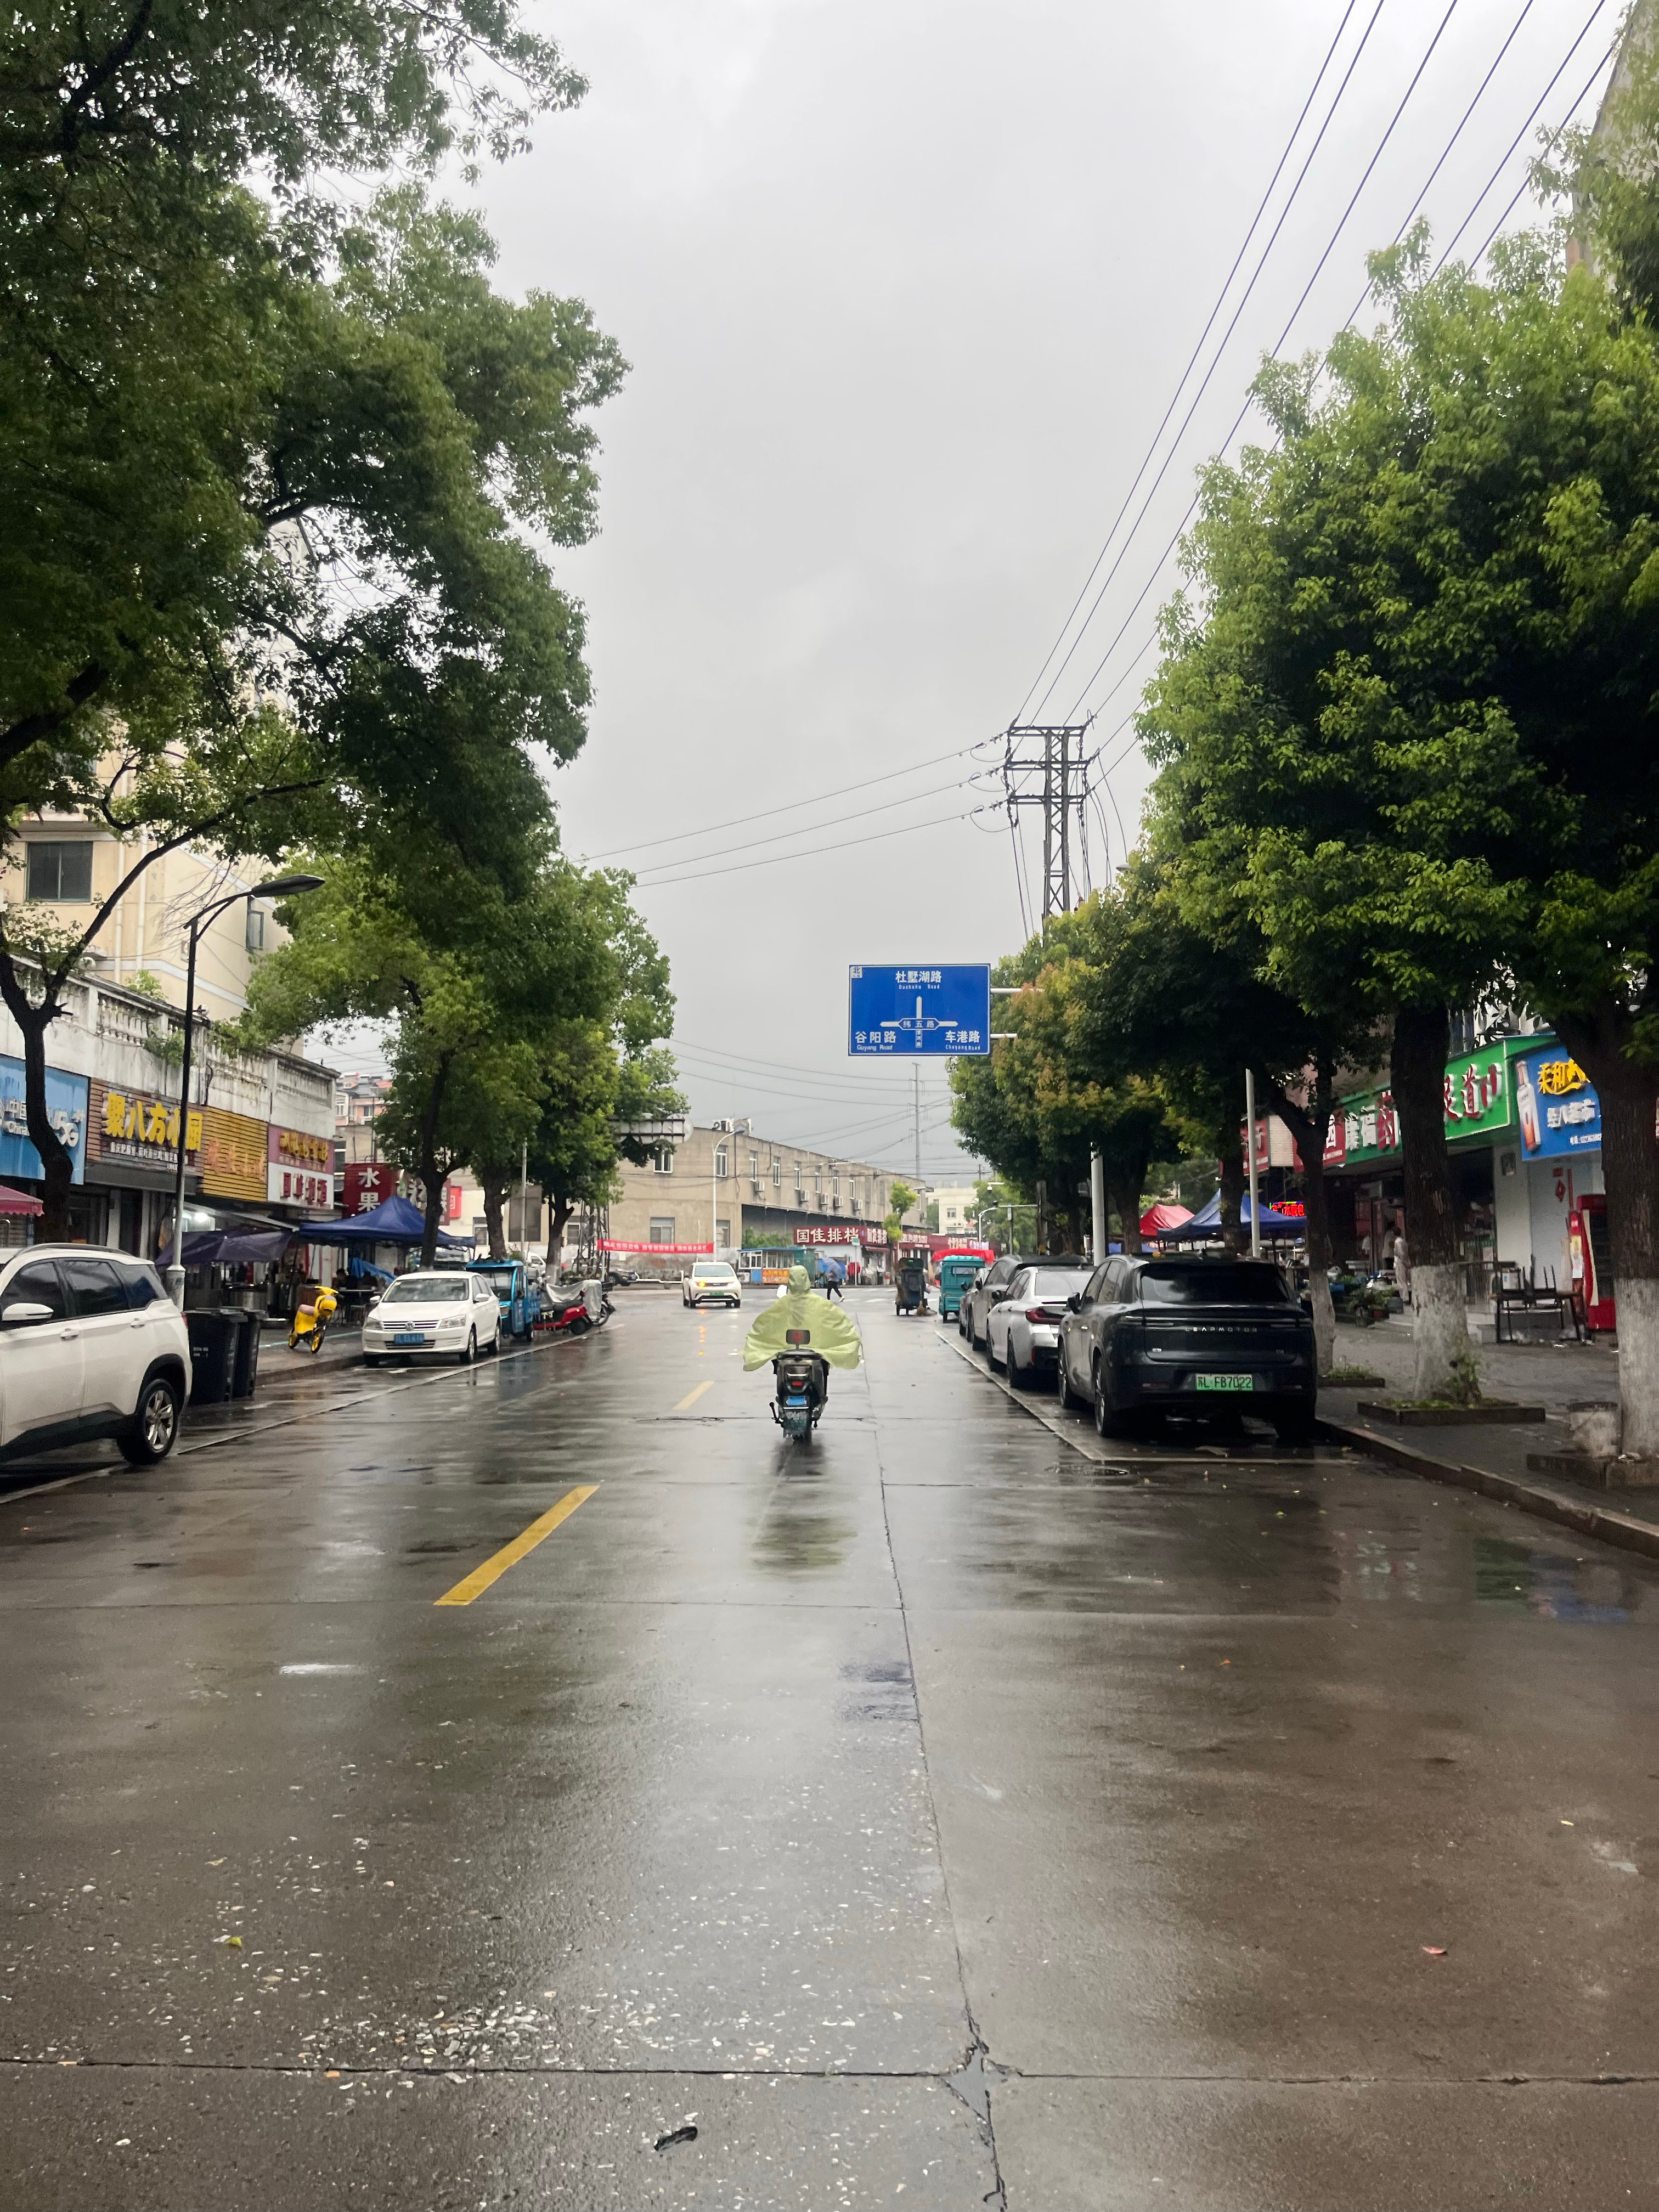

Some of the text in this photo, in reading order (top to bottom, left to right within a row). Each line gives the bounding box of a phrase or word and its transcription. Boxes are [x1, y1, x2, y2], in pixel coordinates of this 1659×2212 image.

[895, 970, 941, 983] 杜墅湖路
[855, 1031, 896, 1043] 谷阳路
[945, 1030, 980, 1043] 车港路
[358, 1167, 381, 1211] 水果
[797, 1227, 860, 1243] 国佳排档
